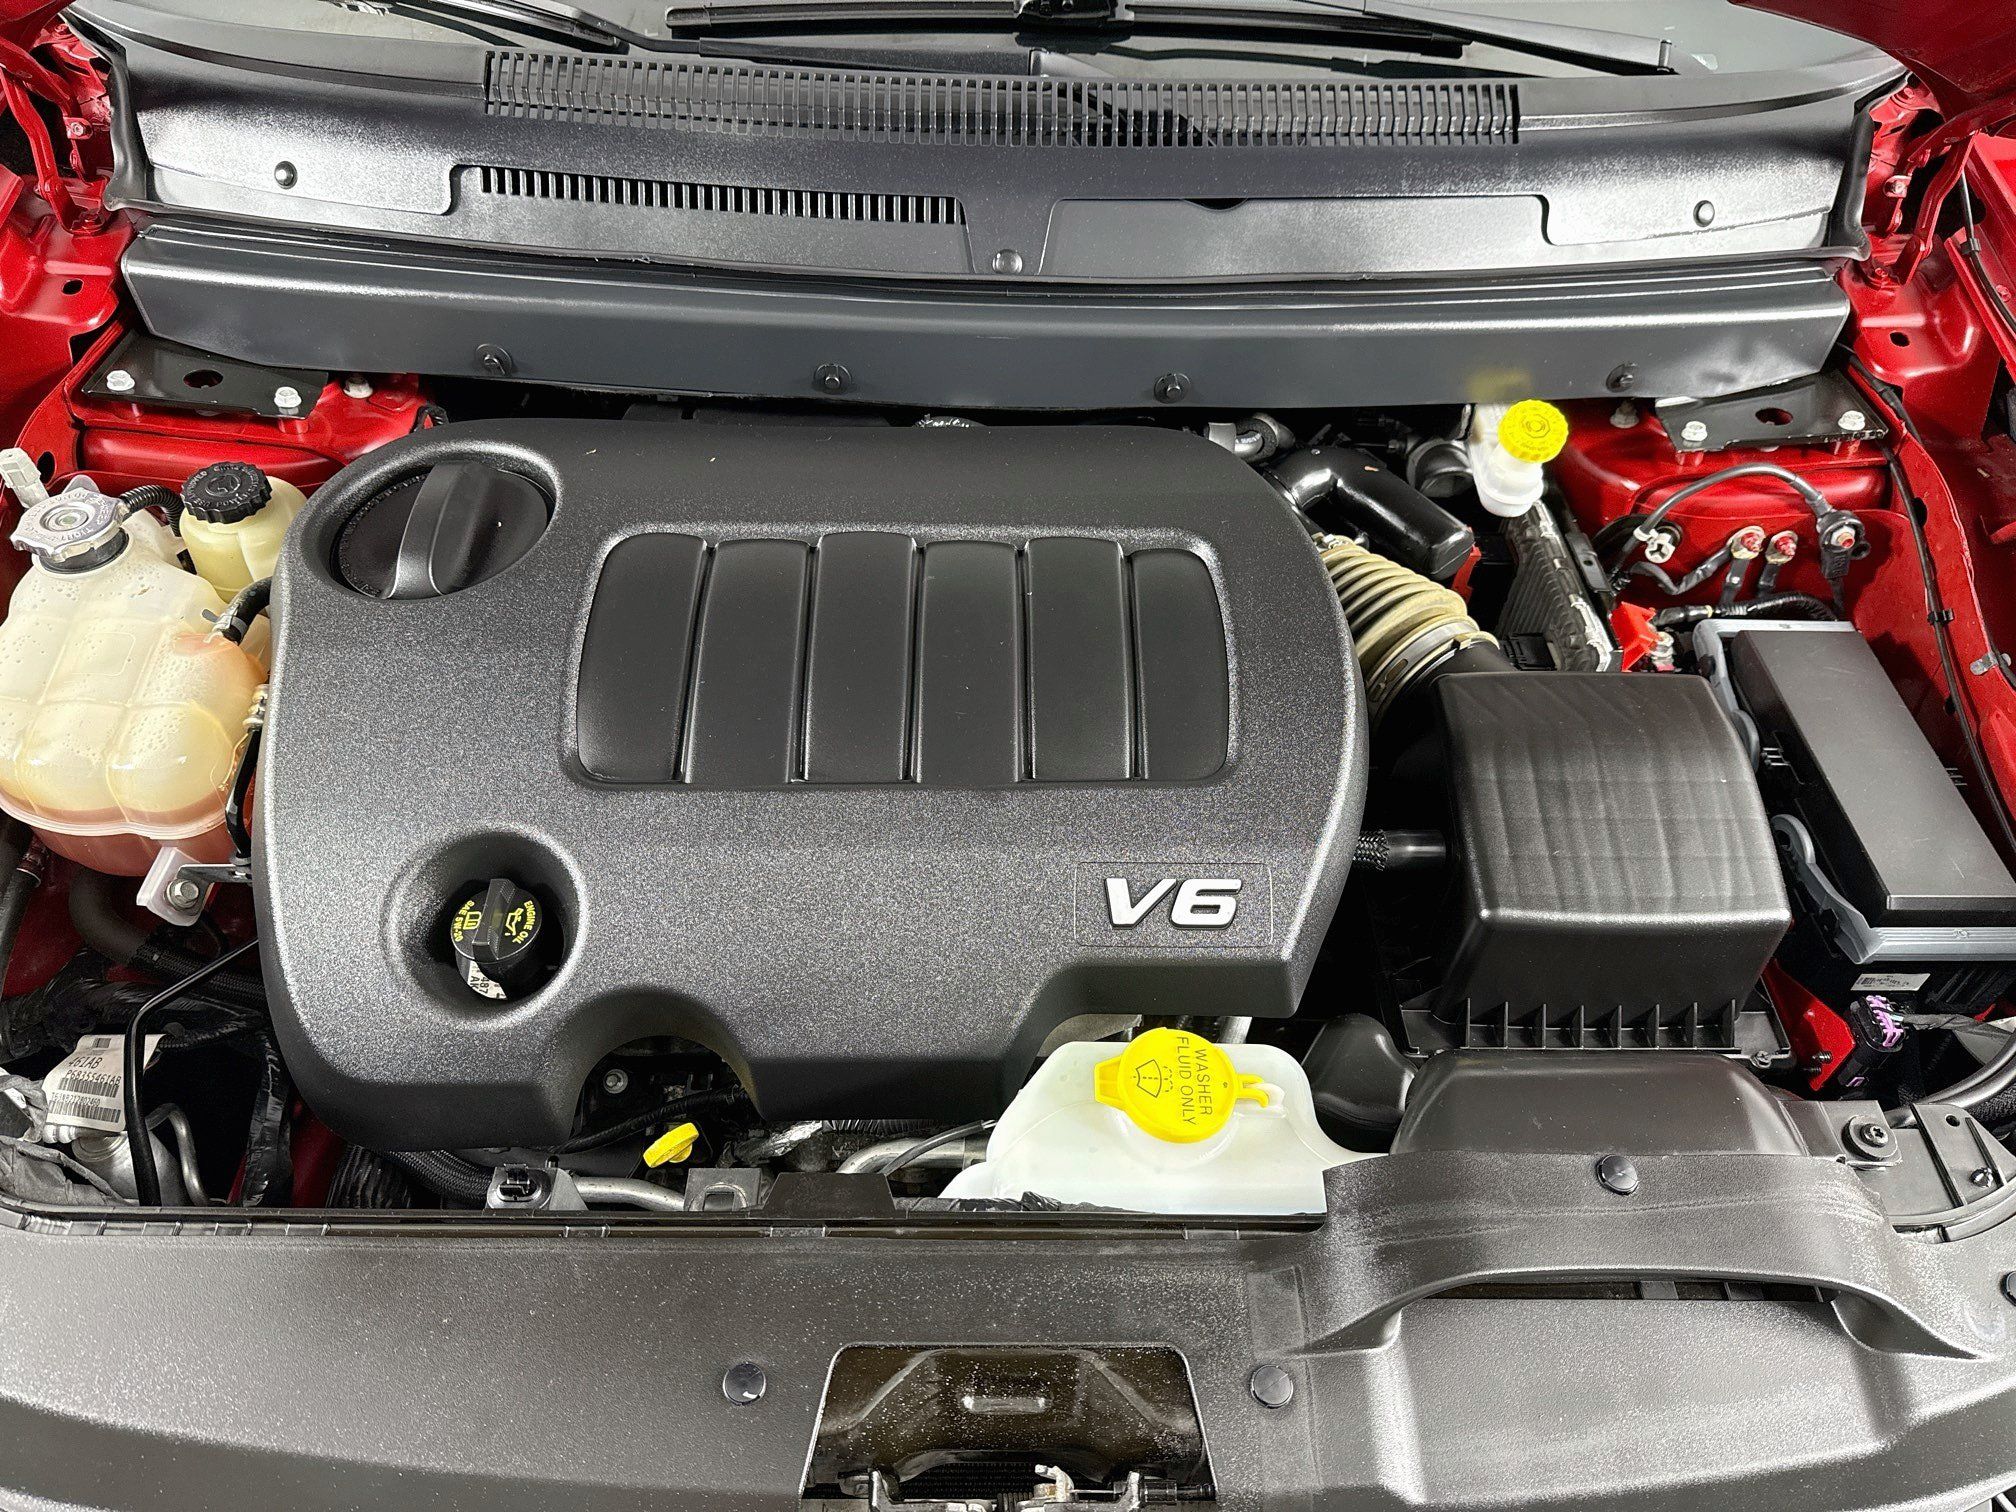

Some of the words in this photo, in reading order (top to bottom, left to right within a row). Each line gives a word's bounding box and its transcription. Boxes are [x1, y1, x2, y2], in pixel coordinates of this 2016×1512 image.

[459, 900, 475, 916] SAE
[523, 900, 537, 931] ENGINE
[1105, 877, 1243, 929] V6
[453, 916, 464, 943] 5W-20
[512, 930, 529, 945] OIL
[1176, 1036, 1193, 1080] FLUID
[1194, 1048, 1214, 1116] WASHER
[1180, 1085, 1198, 1126] ONLY
